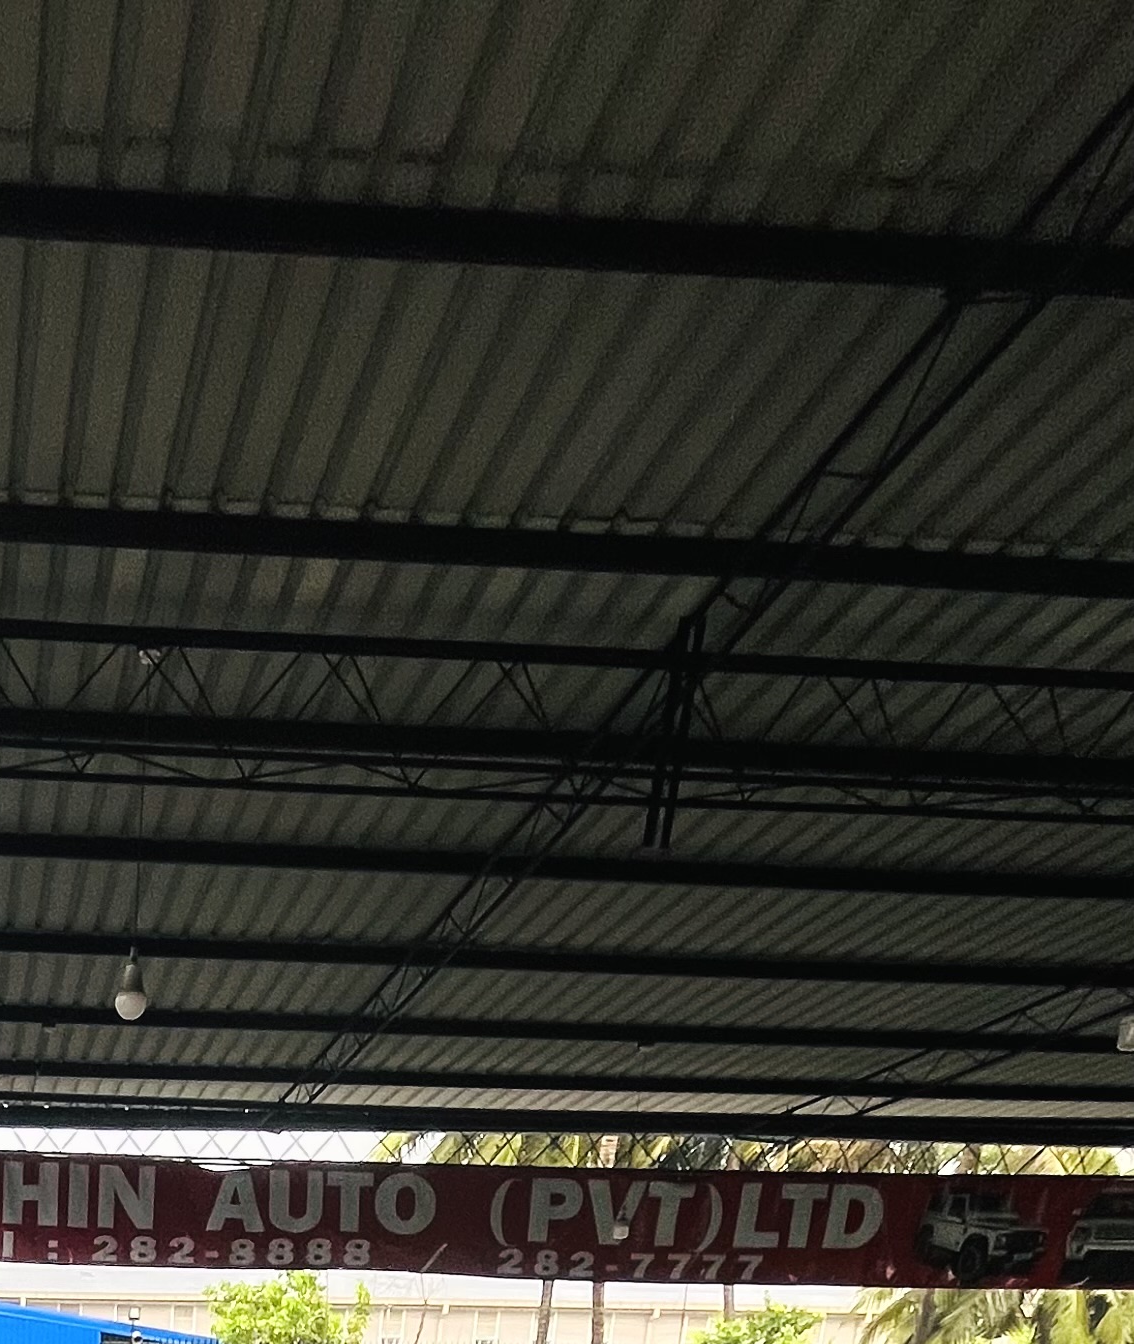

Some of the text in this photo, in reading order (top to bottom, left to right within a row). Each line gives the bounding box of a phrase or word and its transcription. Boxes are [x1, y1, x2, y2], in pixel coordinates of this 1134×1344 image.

[205, 1169, 437, 1236] AUTO
[92, 1234, 372, 1268] 282-8888
[497, 1246, 765, 1281] 282-7777
